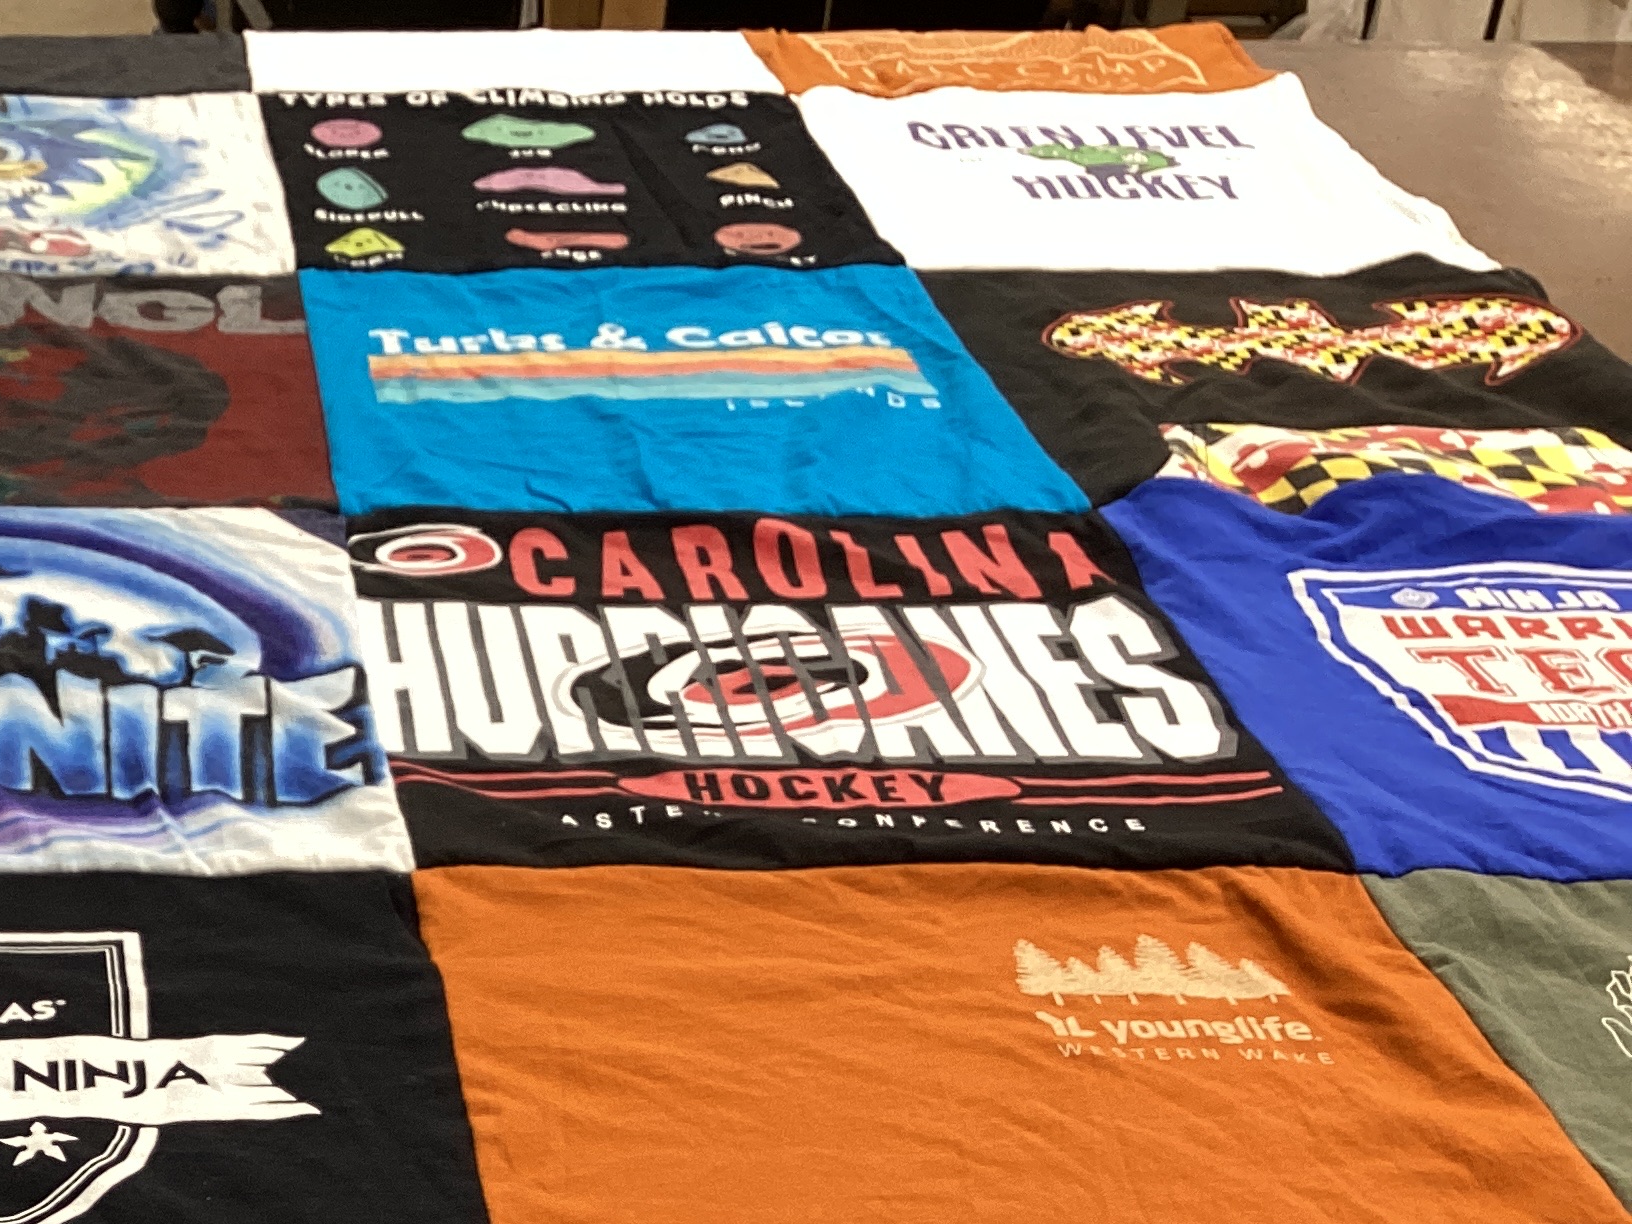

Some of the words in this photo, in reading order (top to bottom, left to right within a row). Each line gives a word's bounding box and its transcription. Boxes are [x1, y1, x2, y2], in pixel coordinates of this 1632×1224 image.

[279, 92, 387, 108] TYPES
[405, 91, 448, 107] OF
[642, 91, 750, 108] HOLDS
[590, 322, 648, 351] &
[510, 518, 1120, 601] CAROLINA
[1454, 586, 1621, 612] NINJA
[685, 770, 948, 804] HOCKEY
[1057, 1042, 1221, 1061] WESTERN
[1238, 1048, 1336, 1065] WAKE
[13, 1057, 210, 1099] NINJA
